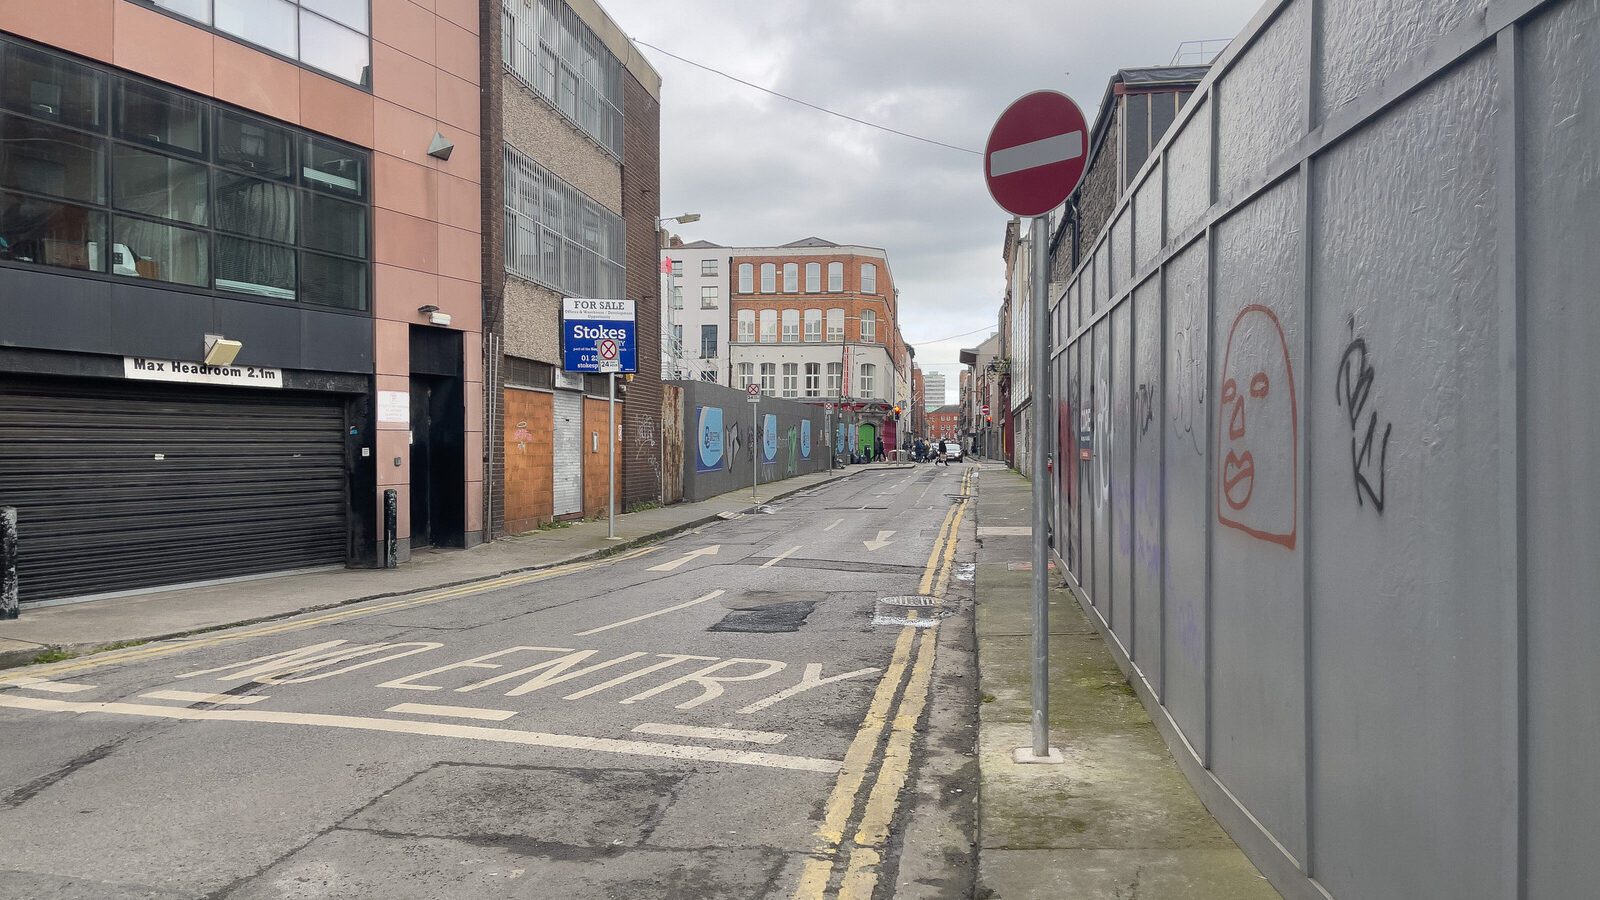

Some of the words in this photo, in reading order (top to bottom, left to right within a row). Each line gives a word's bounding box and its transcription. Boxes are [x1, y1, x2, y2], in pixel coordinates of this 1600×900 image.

[574, 301, 597, 310] FOR
[600, 301, 625, 311] SALE
[573, 325, 626, 339] Stokes
[133, 358, 164, 372] Max
[171, 361, 242, 377] Headroom
[247, 367, 276, 380] 2.1m
[174, 639, 445, 685] NO
[375, 645, 882, 715] ENTRY
